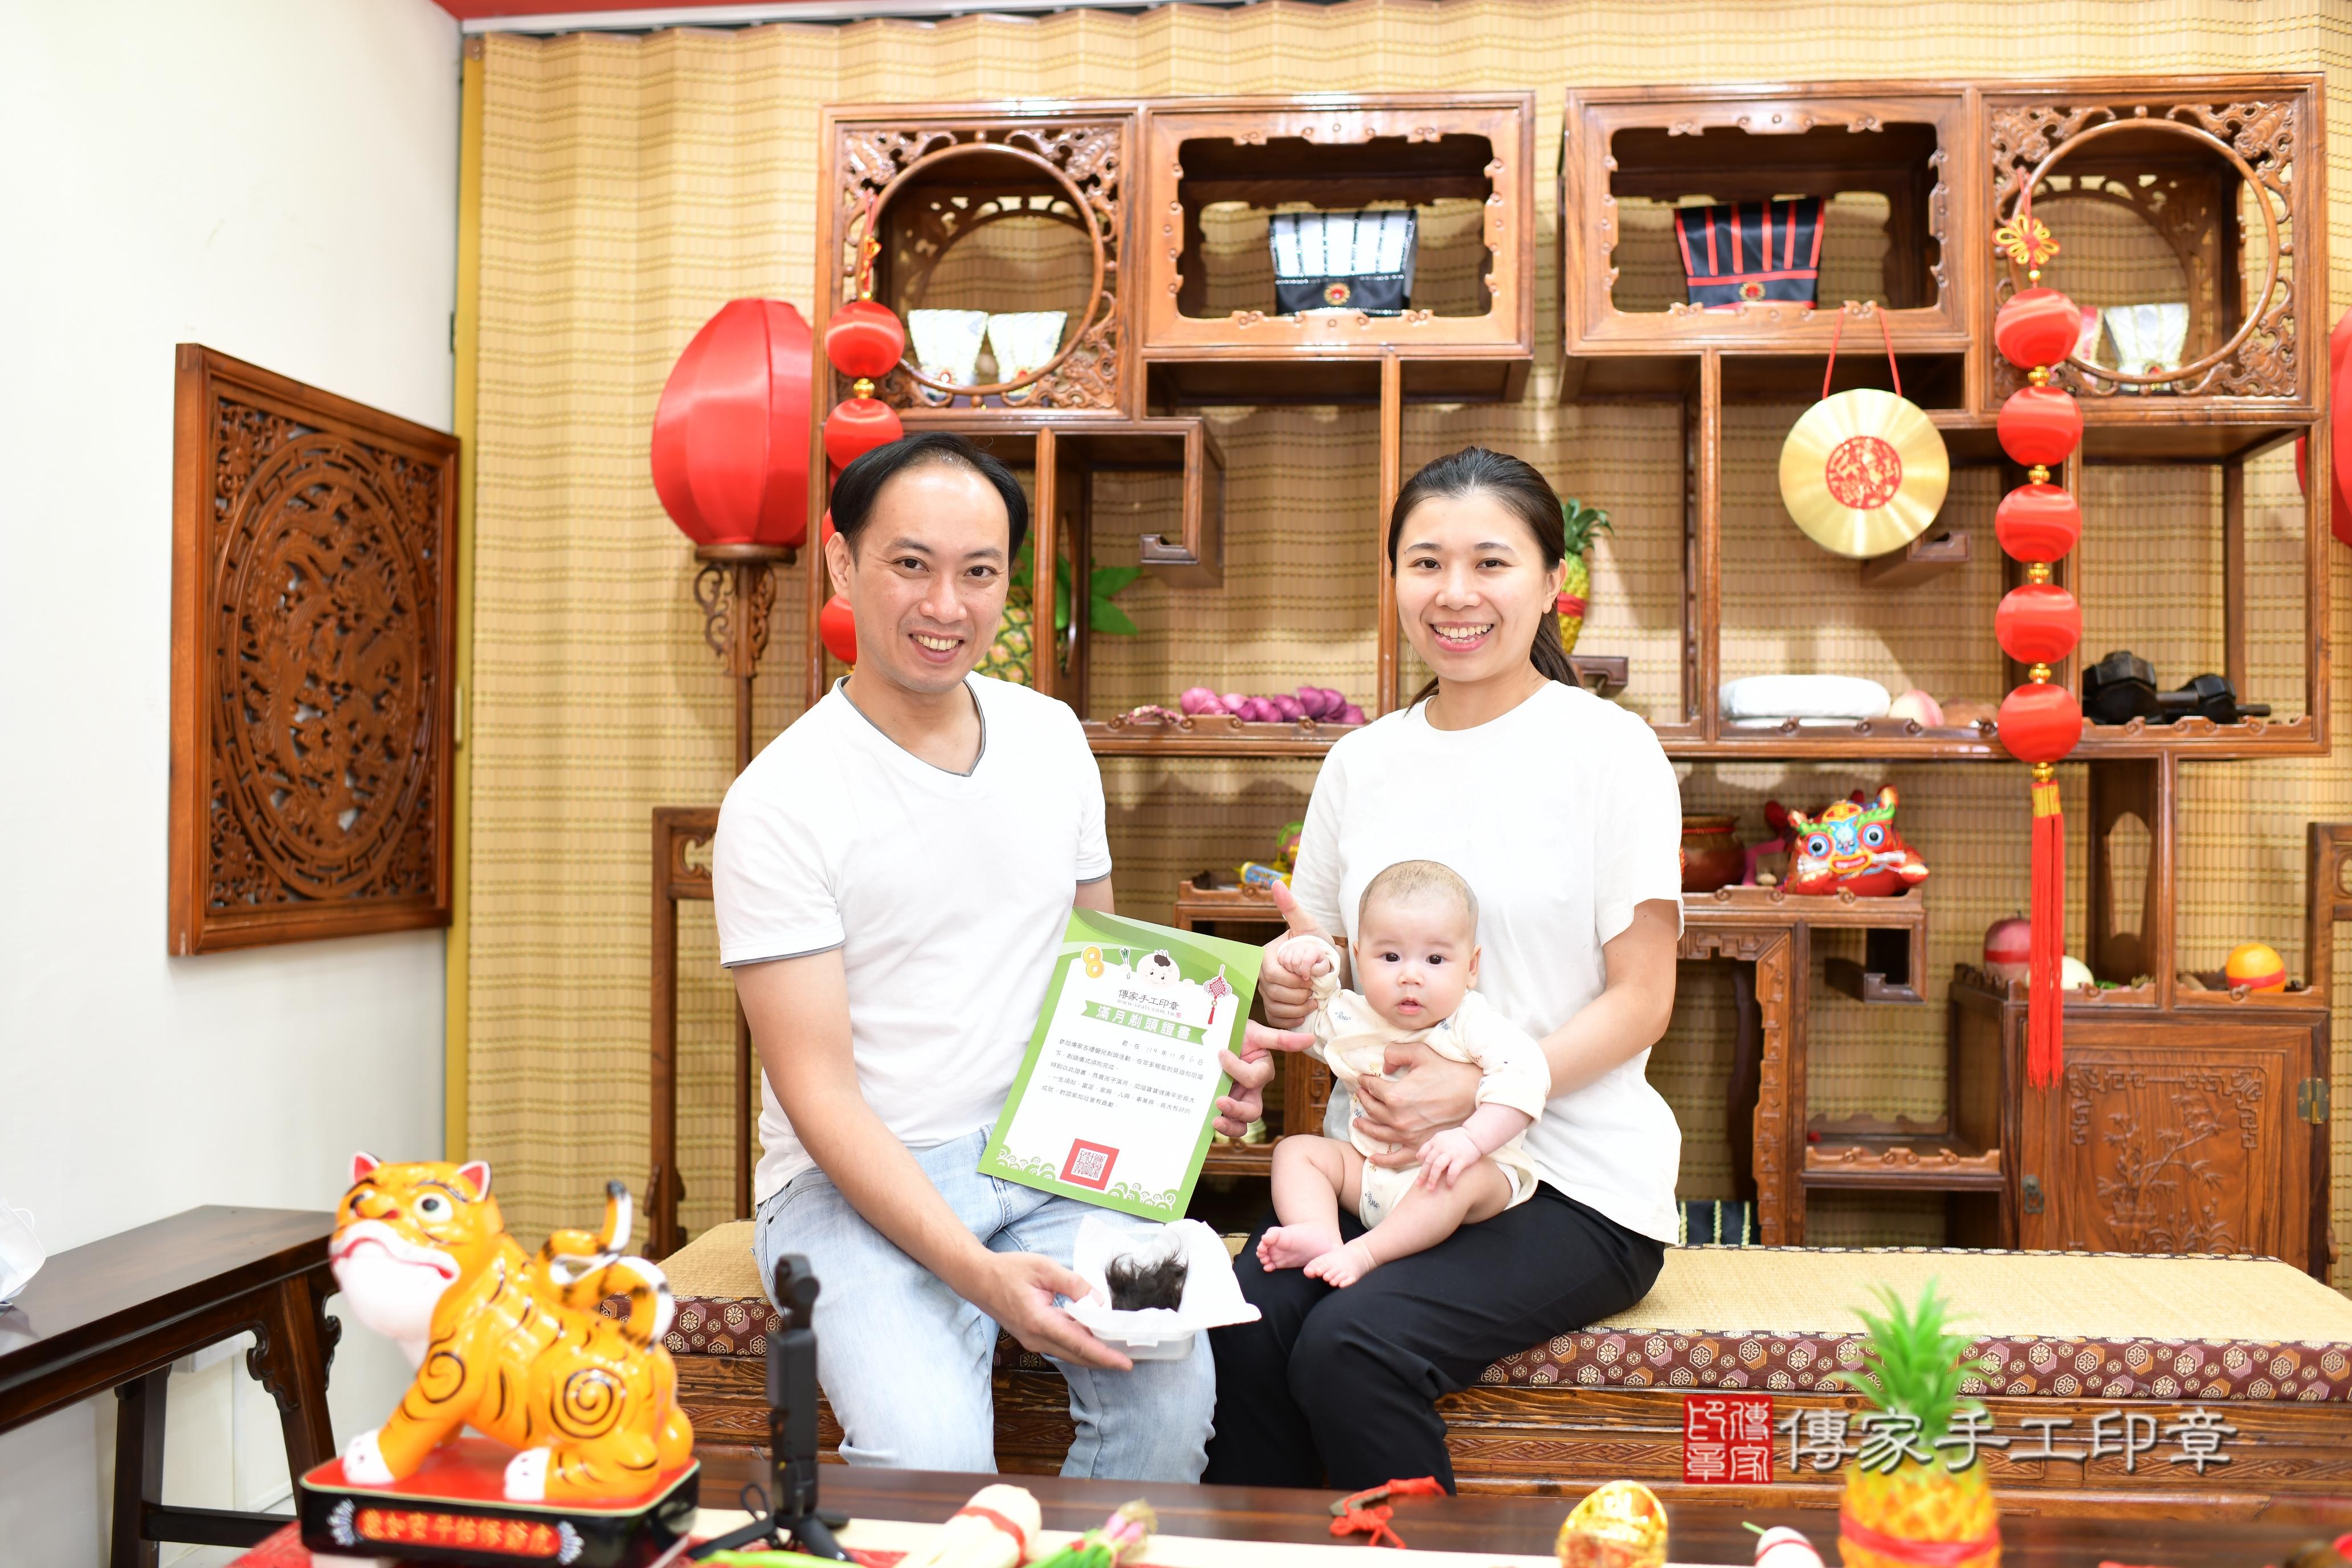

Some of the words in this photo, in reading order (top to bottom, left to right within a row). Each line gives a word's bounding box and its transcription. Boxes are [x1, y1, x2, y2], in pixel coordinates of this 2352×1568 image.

[1116, 998, 1175, 1016] www.seals.com.tw
[1117, 988, 1179, 1011] 傳家手工印章
[1096, 1004, 1192, 1040] 滿月剃頭證書
